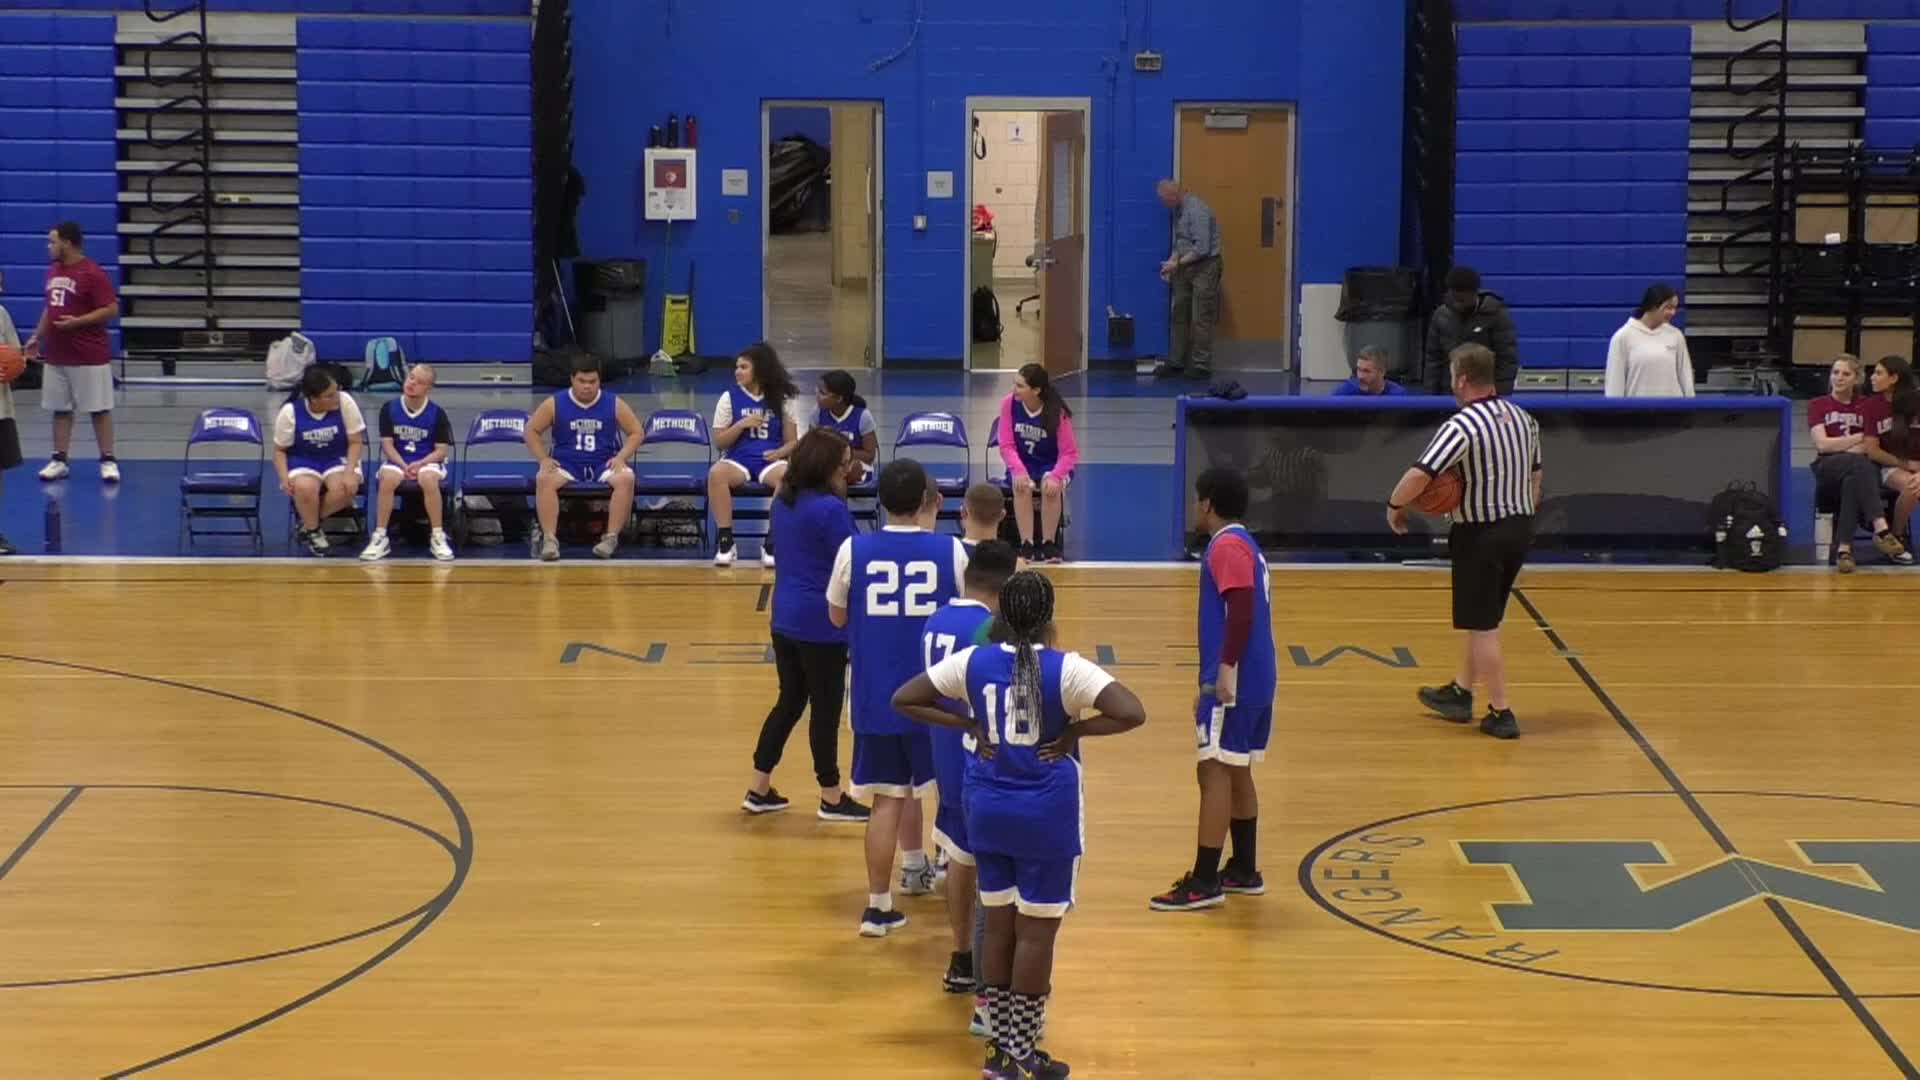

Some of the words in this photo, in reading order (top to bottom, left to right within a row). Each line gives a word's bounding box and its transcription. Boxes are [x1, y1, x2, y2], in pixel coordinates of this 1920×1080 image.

[575, 434, 596, 452] 19
[652, 417, 697, 432] METHUEN
[865, 560, 938, 616] 22
[1323, 832, 1561, 964] RANGERS
